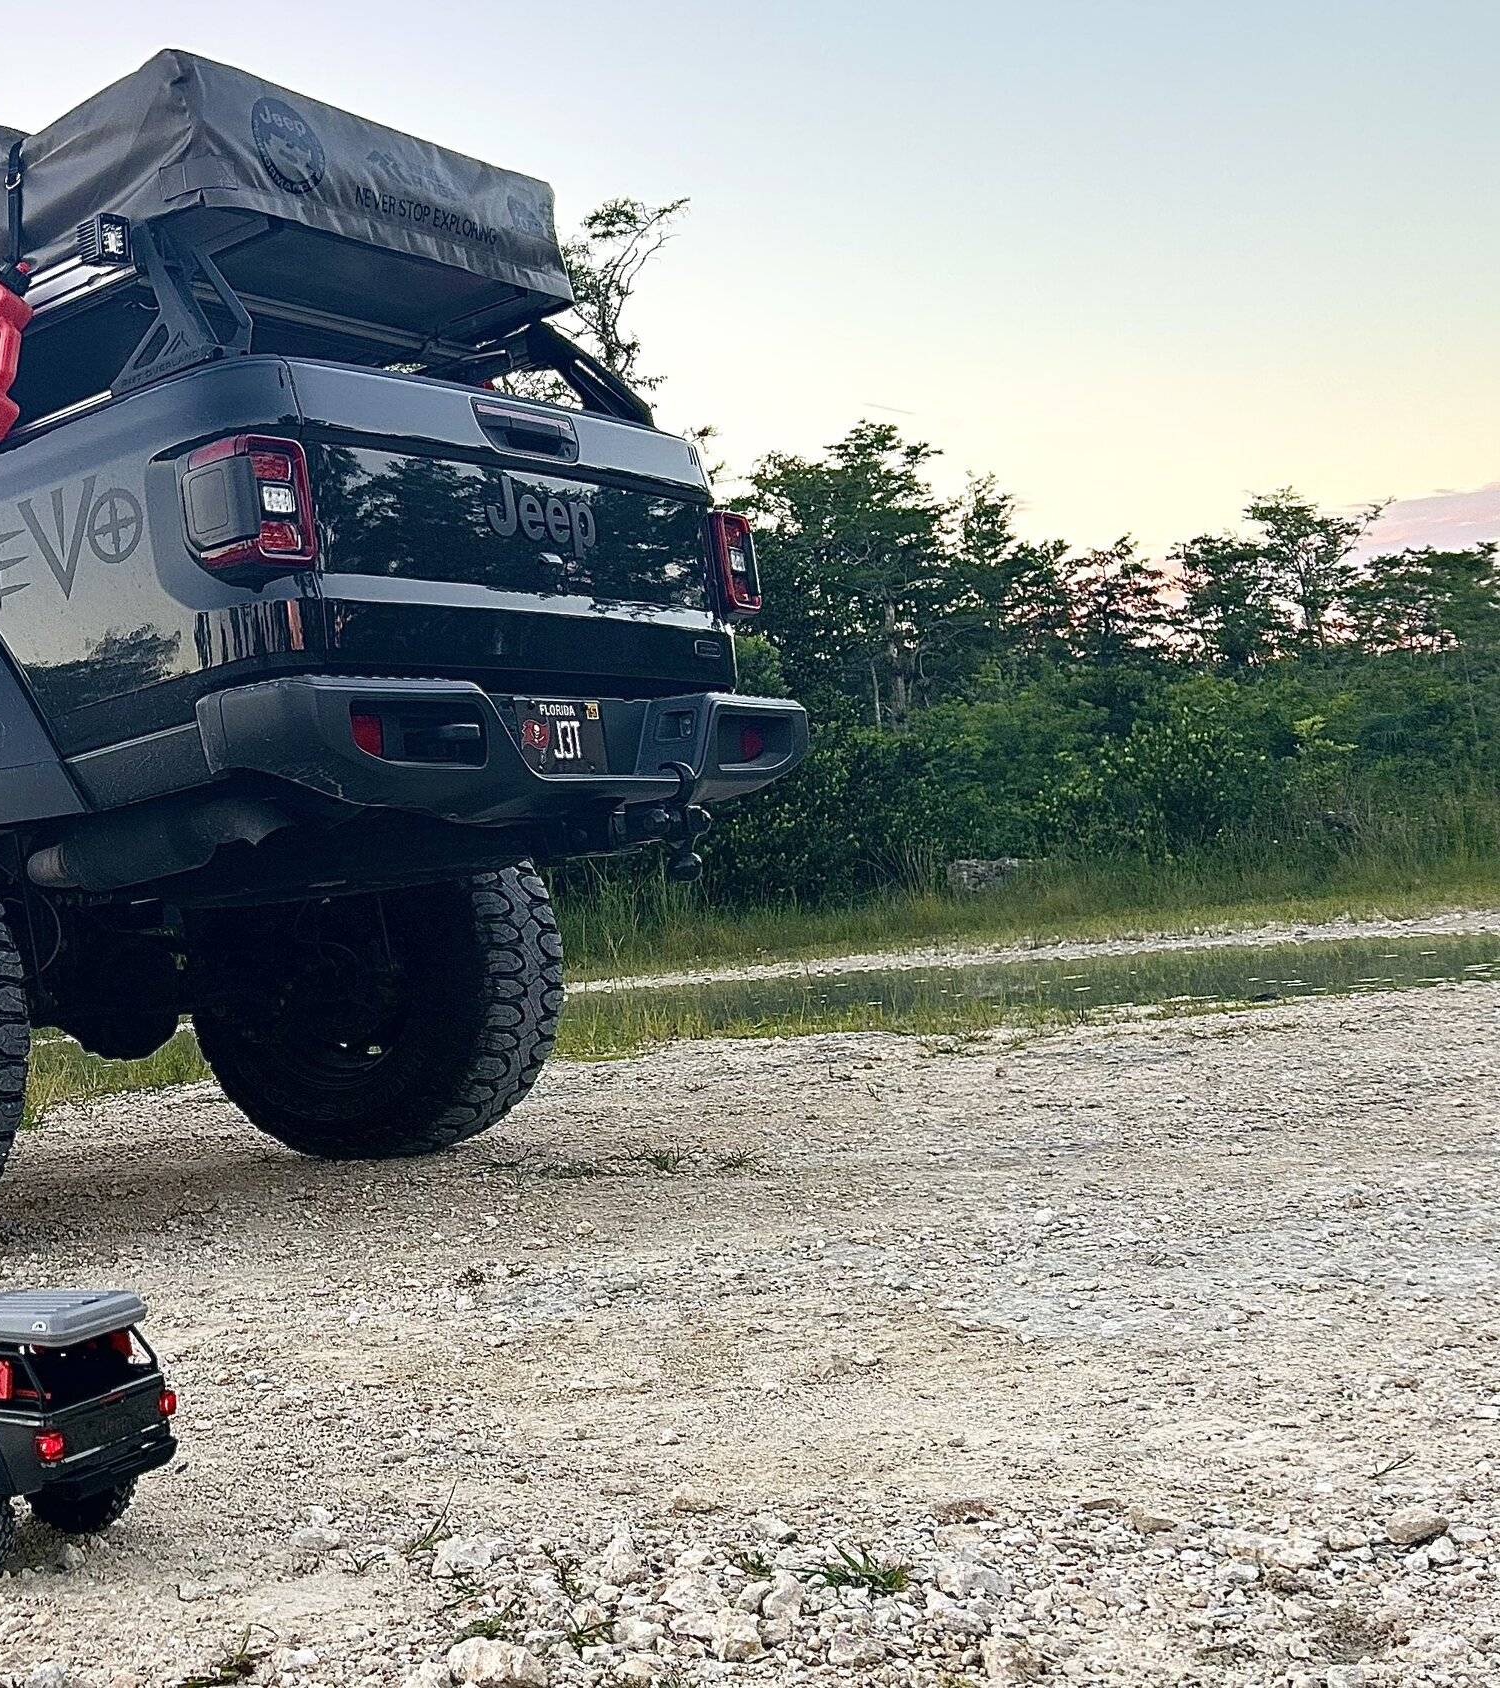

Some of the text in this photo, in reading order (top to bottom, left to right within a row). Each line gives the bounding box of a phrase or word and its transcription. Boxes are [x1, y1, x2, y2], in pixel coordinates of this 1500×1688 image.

[260, 105, 306, 137] Jeep
[355, 185, 395, 215] NEVER
[399, 200, 431, 223] STOP
[433, 208, 497, 245] EXPLORING
[486, 475, 596, 559] Jeep
[539, 704, 576, 717] FLORIDA
[554, 720, 581, 759] J3T
